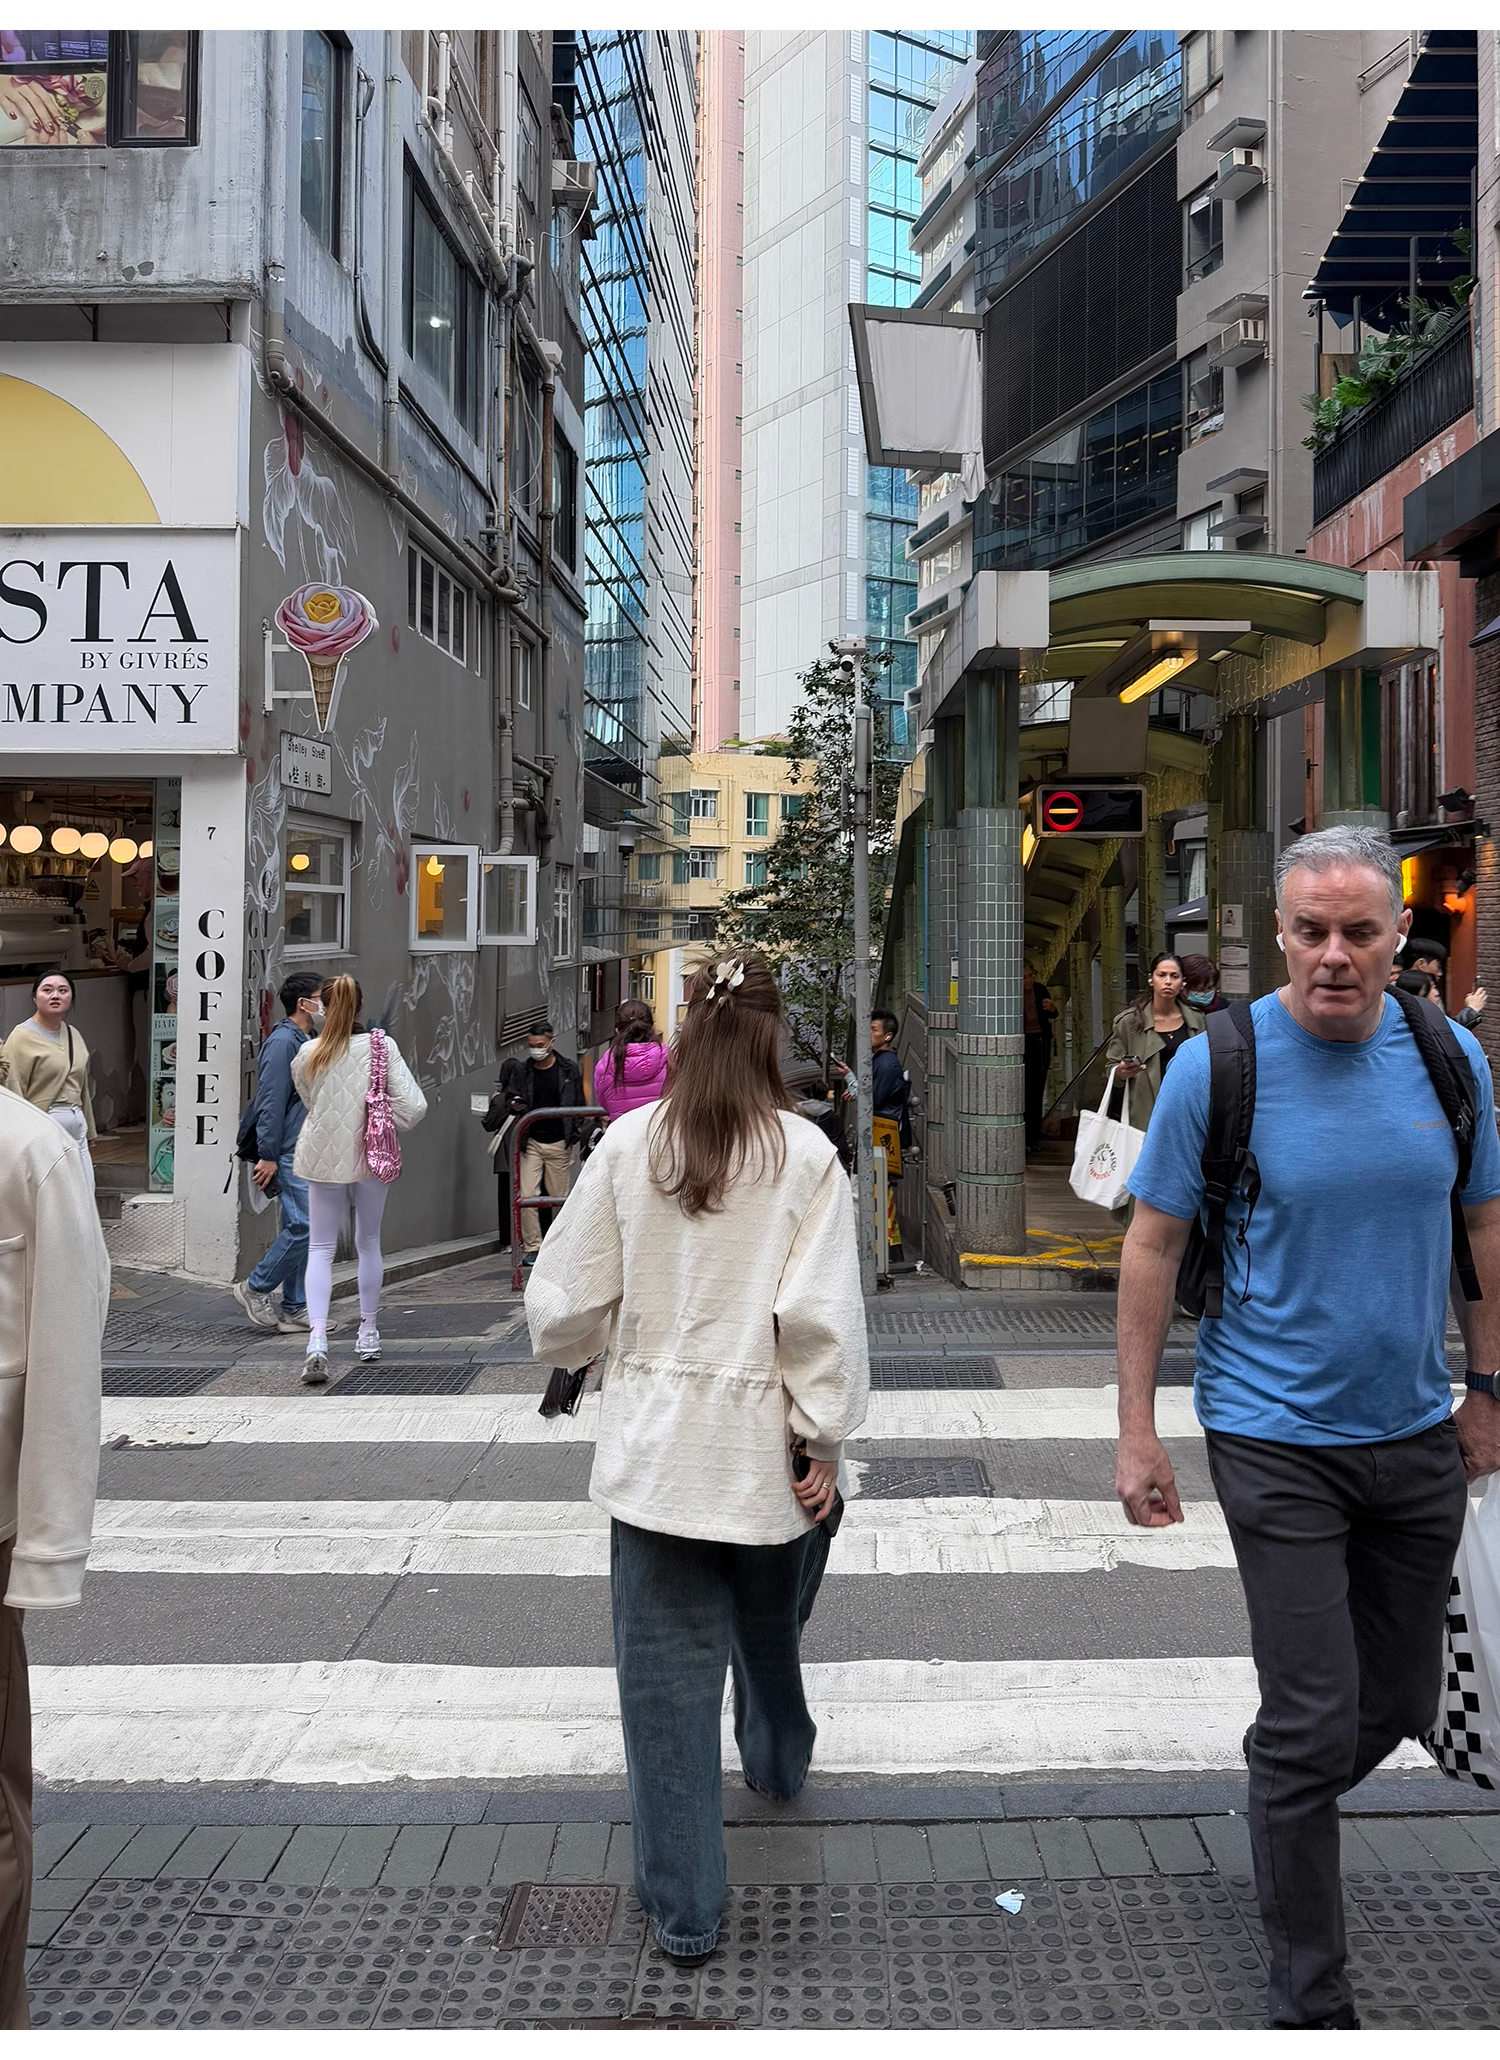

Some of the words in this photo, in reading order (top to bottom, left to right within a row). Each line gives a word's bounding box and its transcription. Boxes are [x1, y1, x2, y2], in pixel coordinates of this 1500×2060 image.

[0, 560, 209, 643] STA
[80, 651, 113, 669] BY
[119, 648, 209, 670] GIVRÉS
[1, 683, 209, 724] MPANY
[206, 826, 217, 841] 7
[195, 908, 227, 1147] COFFEE
